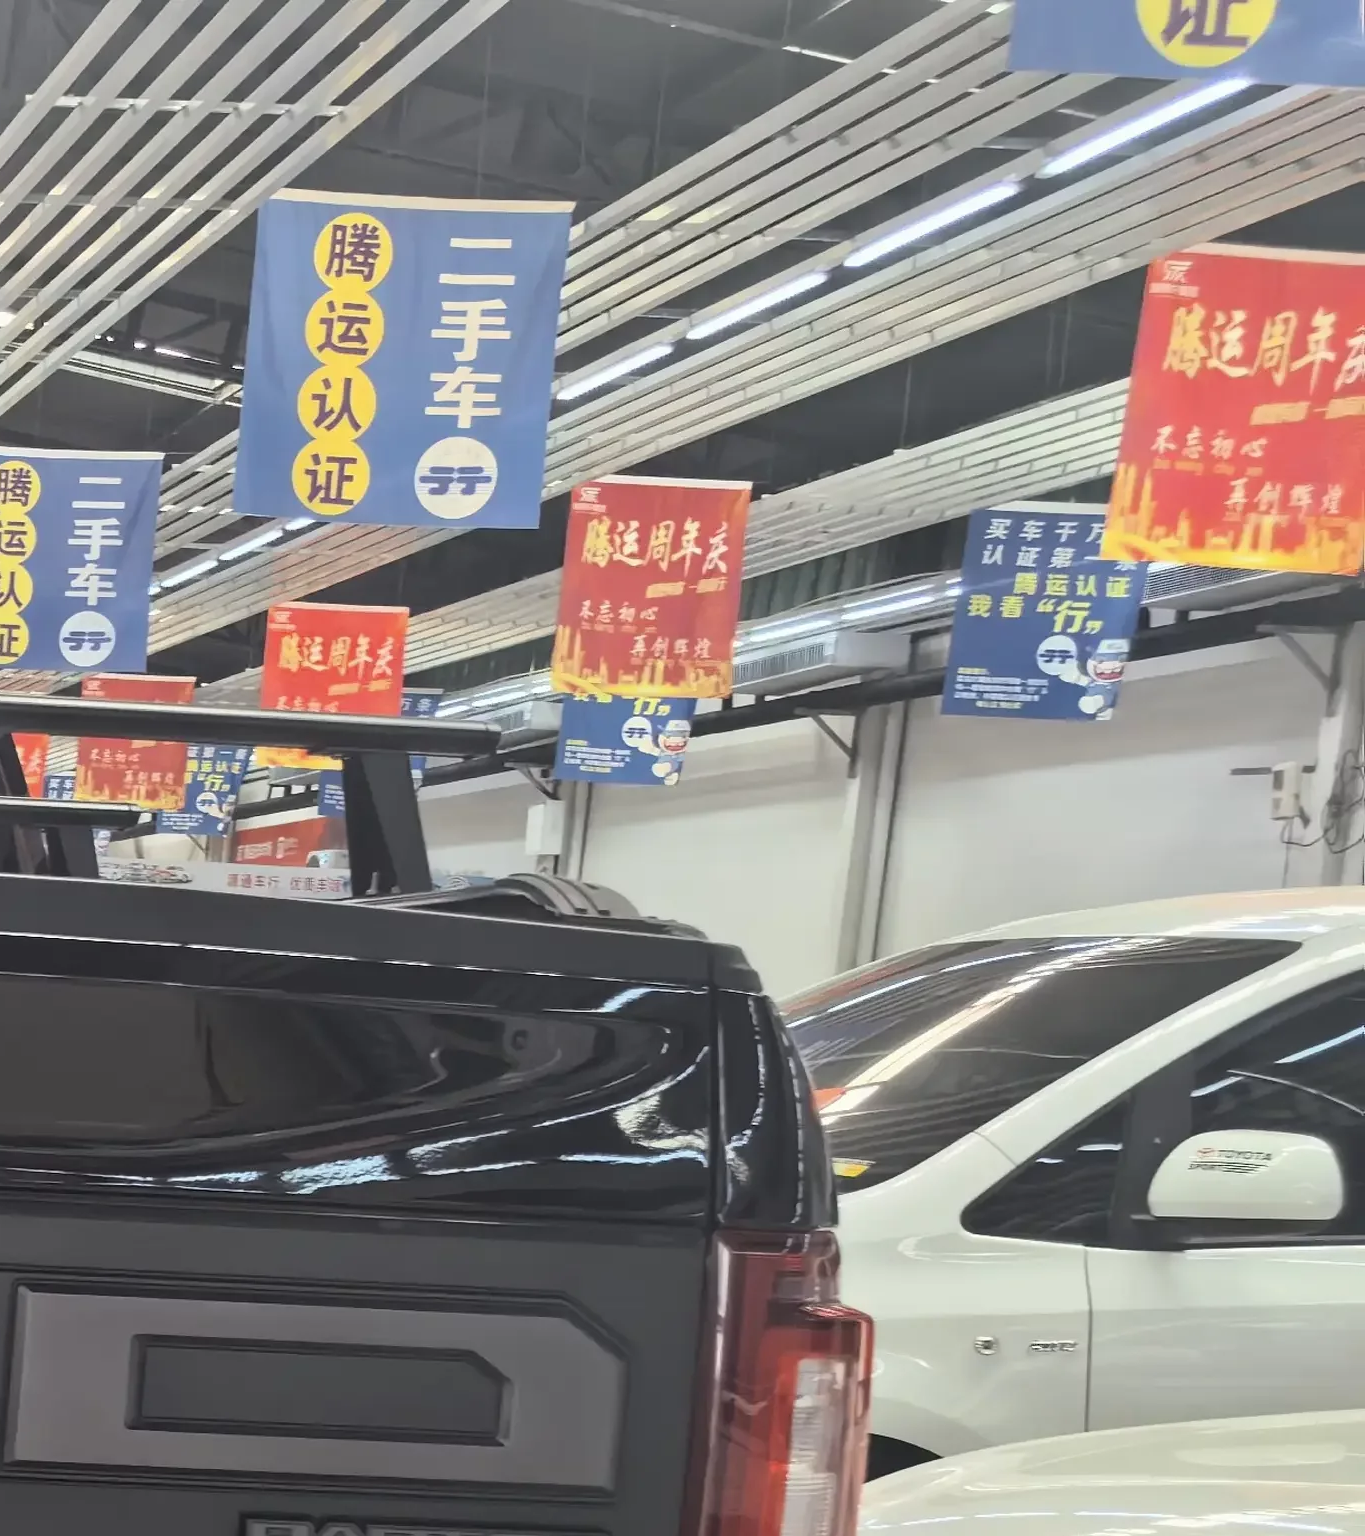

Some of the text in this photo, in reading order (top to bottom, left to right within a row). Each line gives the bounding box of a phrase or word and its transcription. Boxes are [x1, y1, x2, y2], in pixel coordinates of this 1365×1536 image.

[304, 223, 381, 506] 腾运认证
[1150, 425, 1269, 459] 不忘初心
[1224, 477, 1345, 521] 再创辉煌
[984, 518, 1106, 543] 买车千万
[581, 515, 729, 577] 腾运周年庆
[1013, 572, 1132, 598] 腾运认证
[578, 599, 659, 624] 不忘初心
[278, 632, 395, 680] 腾运周年庆
[629, 634, 712, 660] 再创辉煌
[1218, 1149, 1272, 1161] TOYOTA
